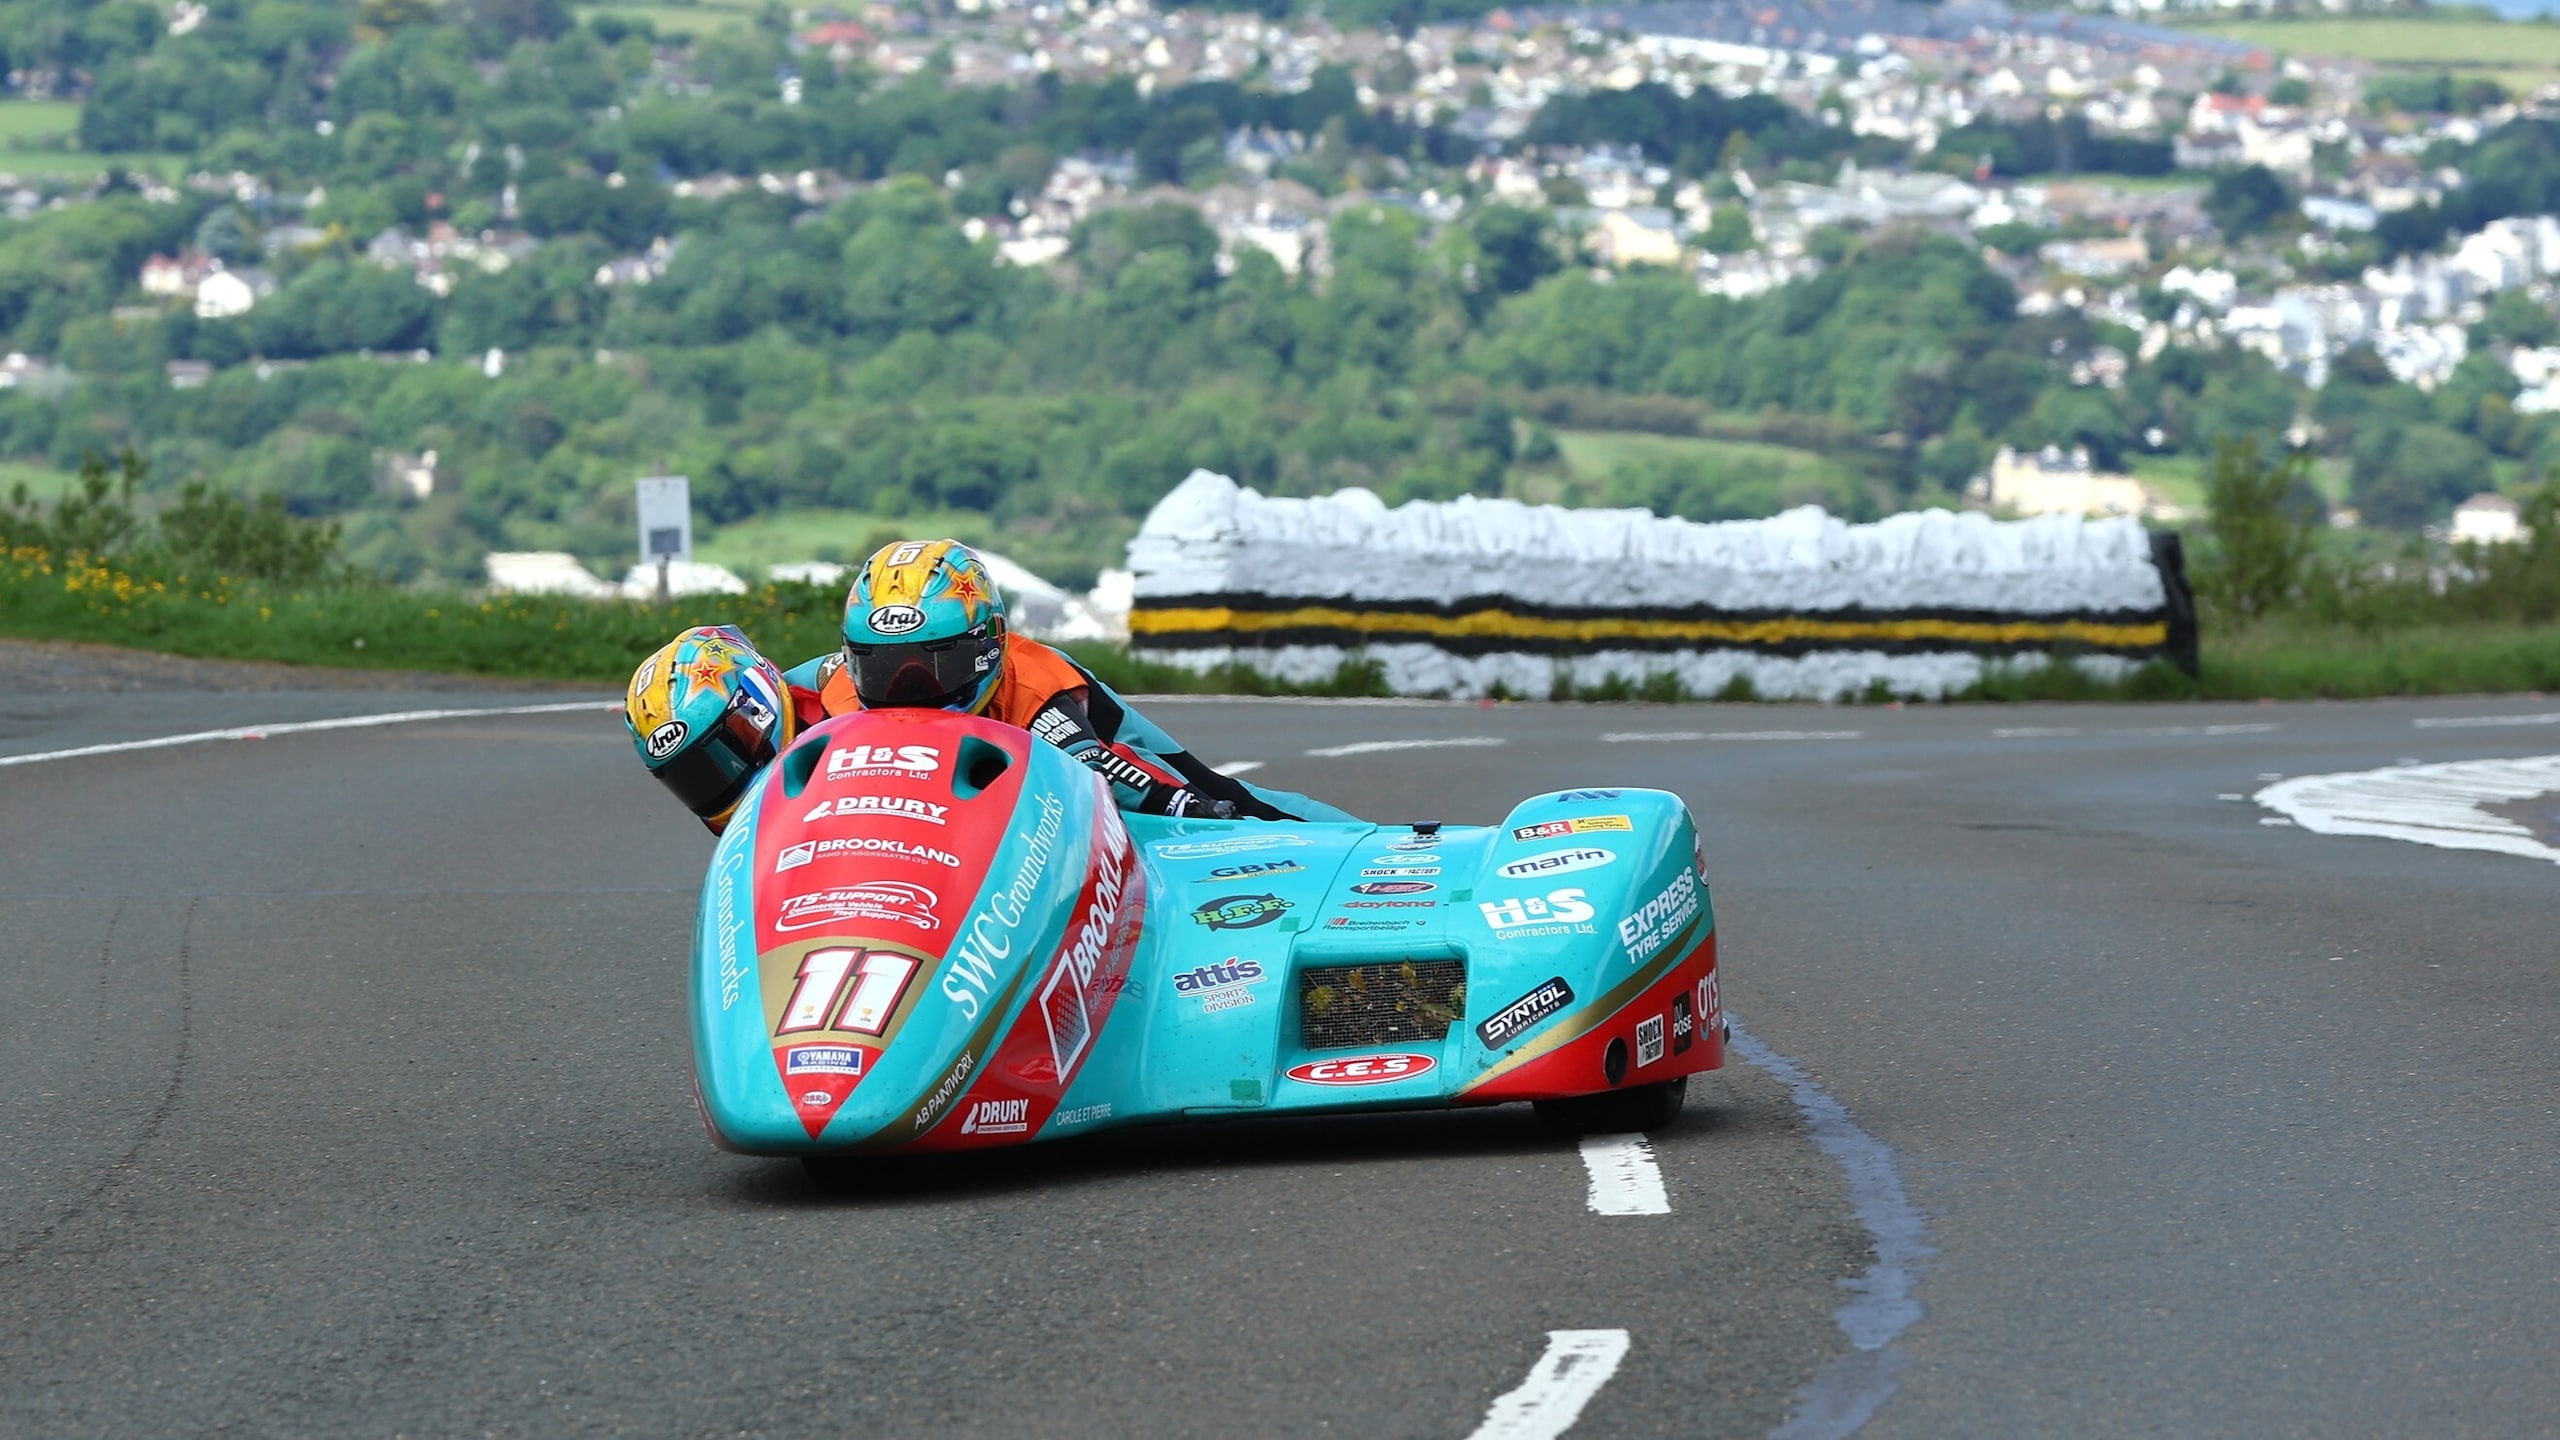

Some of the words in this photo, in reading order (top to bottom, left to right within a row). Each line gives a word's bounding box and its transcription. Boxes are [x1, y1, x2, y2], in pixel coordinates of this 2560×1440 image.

[874, 608, 918, 626] Arai
[649, 723, 683, 756] Arai
[1043, 720, 1082, 745] FACTORY
[827, 745, 939, 772] H&S
[827, 768, 902, 782] Contractors
[908, 770, 931, 781] Ltd.
[835, 796, 949, 818] DRURY
[1519, 823, 1566, 838] B&R
[818, 838, 961, 868] BROOKLAND
[850, 850, 910, 861] AGGREGATES
[911, 857, 929, 866] LTD
[1507, 851, 1605, 875] marin
[1210, 859, 1297, 877] GBM
[1363, 868, 1398, 876] SHOCK
[780, 891, 911, 912] TTS-SUPPORT
[847, 900, 884, 910] Vehicle
[942, 910, 1010, 1022] SWC
[991, 791, 1065, 929] Groundworks
[1478, 888, 1595, 930] H&S
[1618, 866, 1694, 947] EXPRESS
[860, 909, 900, 921] Support
[718, 852, 750, 1011] Groundworks
[1496, 924, 1571, 940] Contractors
[1575, 922, 1598, 934] Ltd.
[1626, 929, 1661, 964] TYRE
[1661, 891, 1697, 939] SERVICE
[1174, 958, 1262, 991] attis
[775, 946, 923, 1037] 11
[1204, 987, 1247, 1003] SPORTS
[1204, 995, 1254, 1012] DIVISION
[1485, 986, 1566, 1040] SYNTOL
[1506, 1001, 1560, 1038] LUBRICANTS
[1638, 1016, 1662, 1047] SHOCK
[809, 1050, 852, 1063] YAMAHA
[914, 1109, 931, 1131] AB
[929, 1050, 976, 1115] PAINTWORX
[979, 1099, 1029, 1124] DRURY
[1056, 1108, 1083, 1126] CAROLE
[1083, 1107, 1091, 1122] ET
[1091, 1103, 1112, 1120] PIERRE
